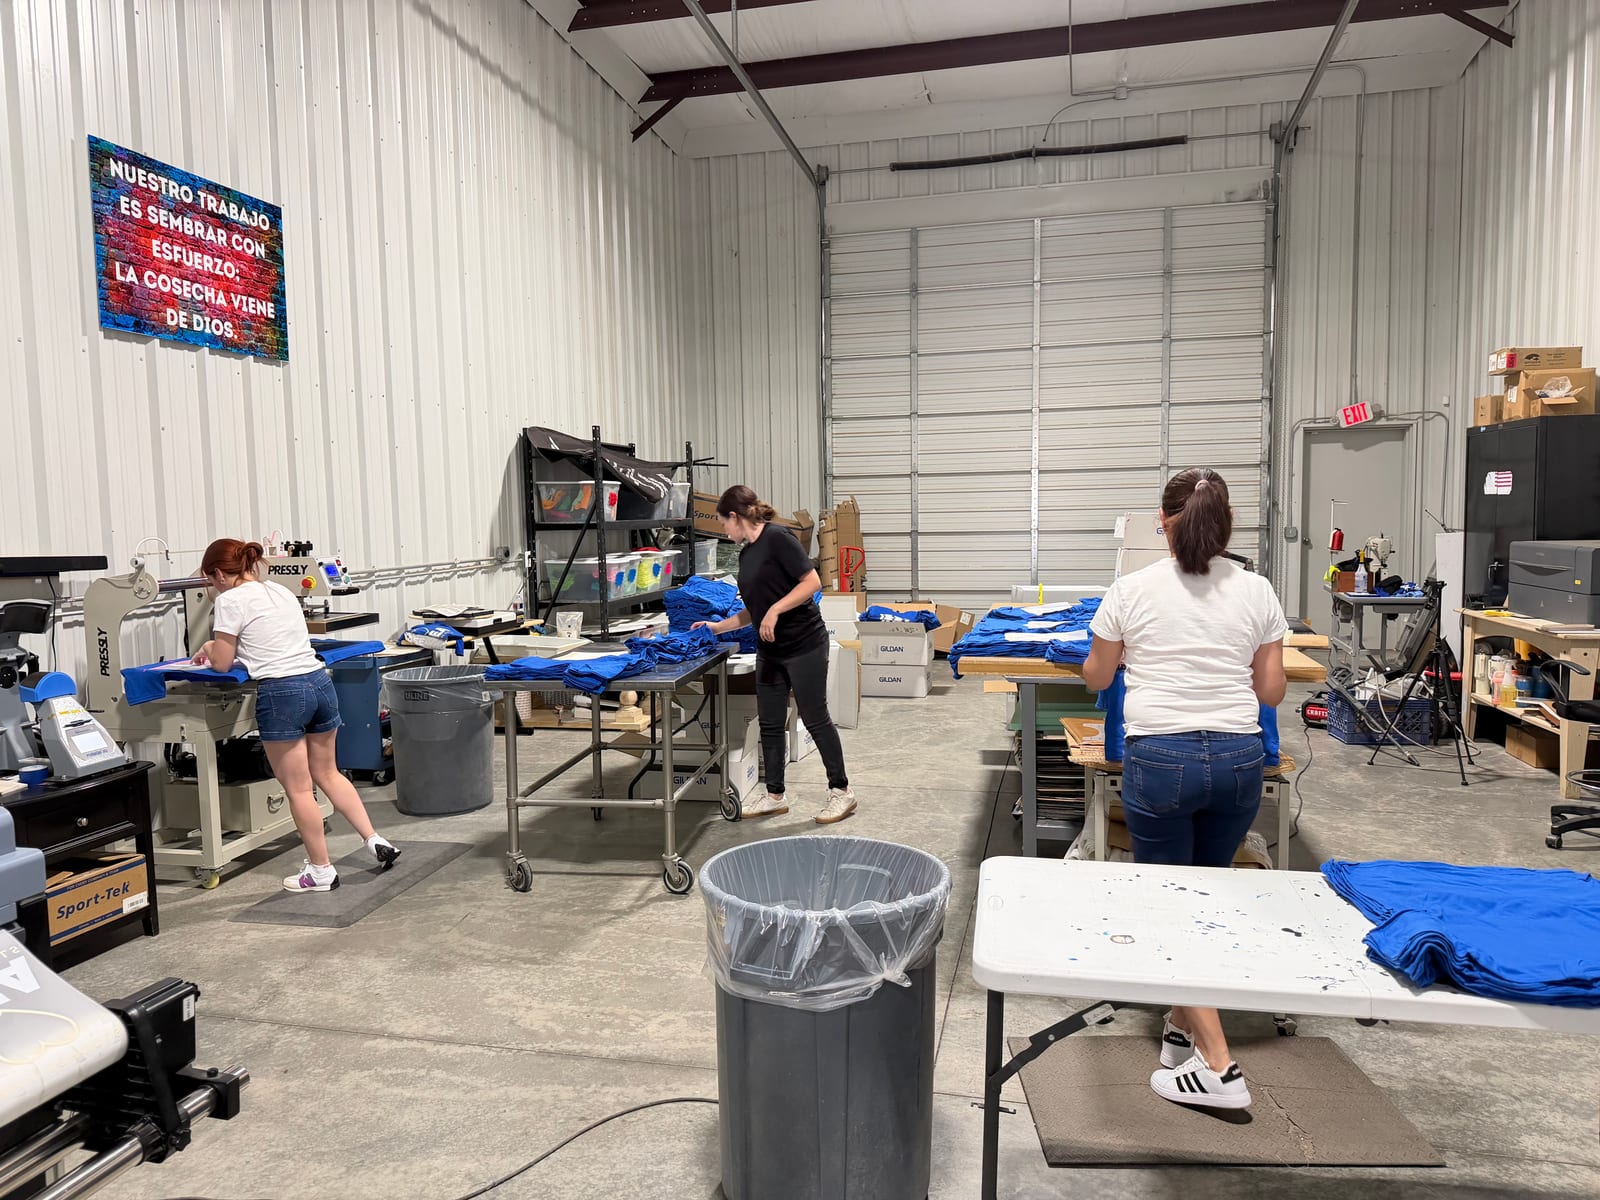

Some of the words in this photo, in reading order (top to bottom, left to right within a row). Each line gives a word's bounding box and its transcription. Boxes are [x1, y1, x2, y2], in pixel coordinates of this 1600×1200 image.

[109, 157, 194, 204] NUESTRO
[198, 190, 270, 231] TRABAJO
[120, 195, 143, 219] ES
[147, 207, 228, 247] SEMBRAR
[231, 233, 266, 259] CON
[115, 262, 139, 285] LA
[143, 273, 227, 306] COSECHA
[230, 292, 275, 319] VIENE
[166, 307, 188, 329] DE
[193, 315, 238, 339] DIOS.
[1343, 402, 1369, 426] EXIT
[267, 564, 309, 576] PRESSLY
[97, 626, 110, 677] PRESSLY
[673, 775, 707, 785] GILN
[56, 881, 131, 920] Sport-Tek
